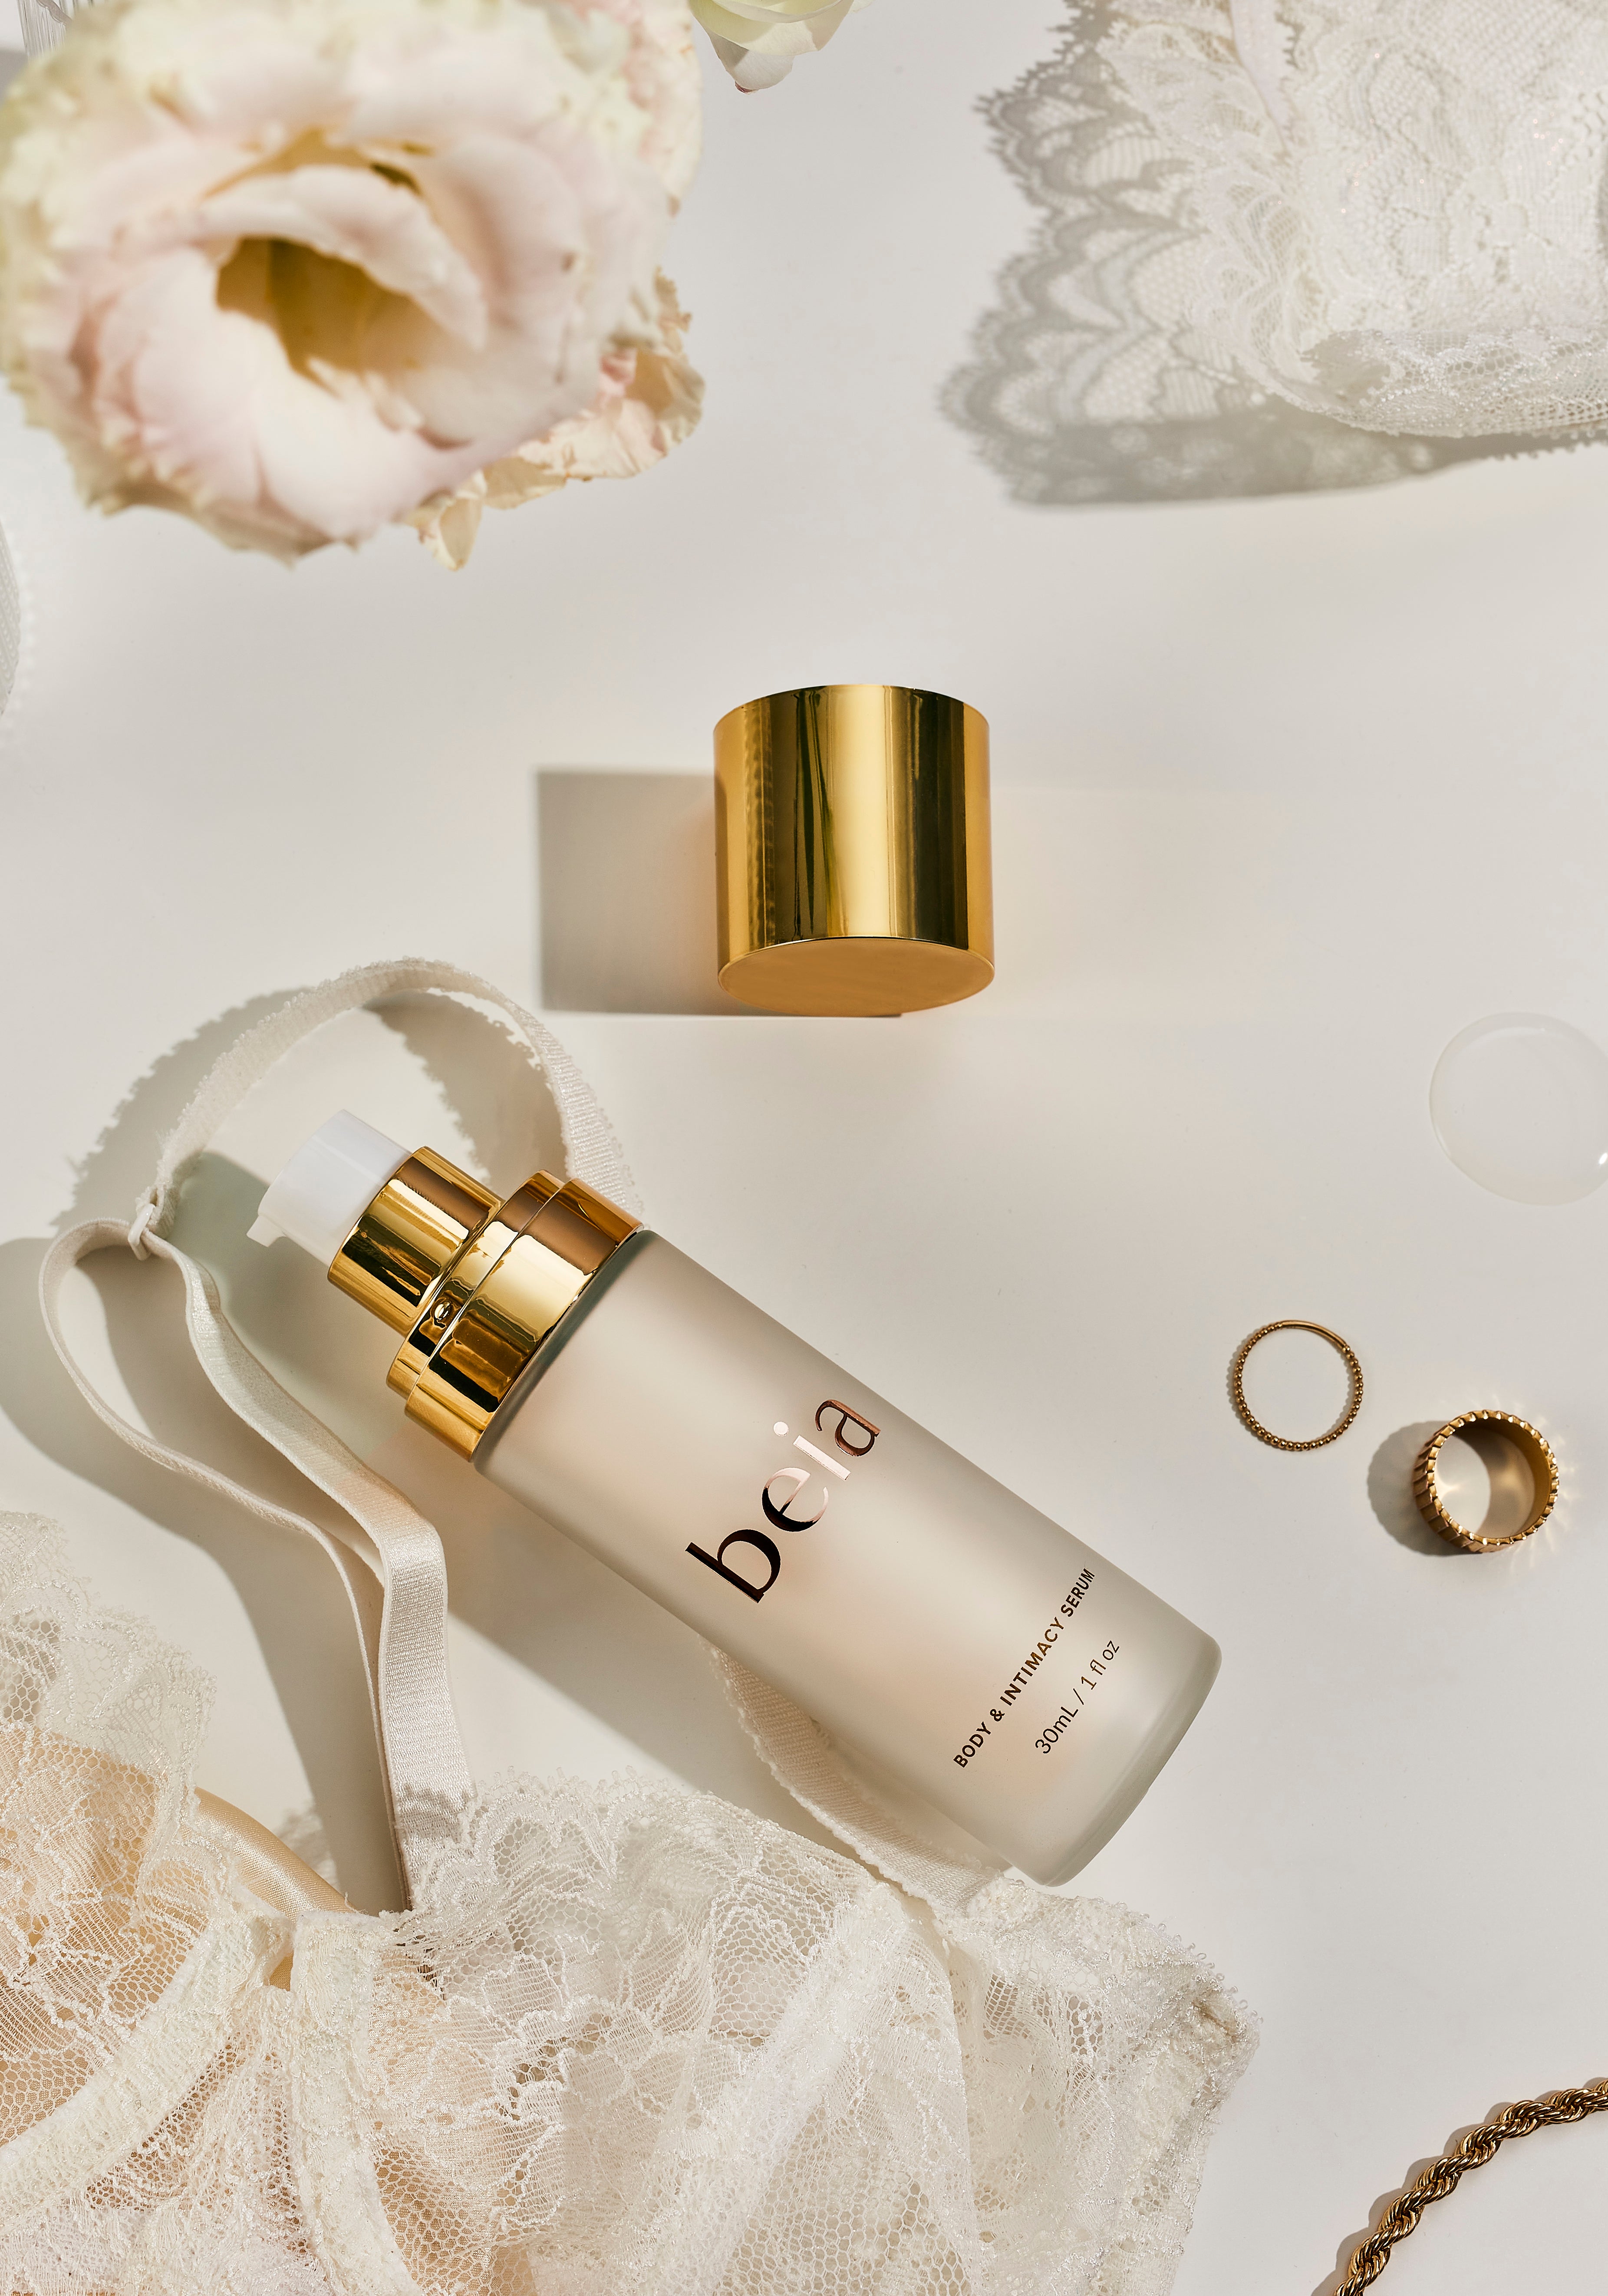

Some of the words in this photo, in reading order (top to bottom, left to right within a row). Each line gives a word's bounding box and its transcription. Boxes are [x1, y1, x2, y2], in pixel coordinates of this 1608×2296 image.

[685, 1399, 881, 1603] beia
[953, 1721, 991, 1768] BODY
[989, 1709, 1005, 1722] &
[1000, 1617, 1064, 1706] INTIMACY
[1061, 1568, 1095, 1617] SERUM
[1035, 1706, 1079, 1754] 30mL
[1073, 1688, 1084, 1705] /
[1081, 1676, 1097, 1690] 1
[1090, 1659, 1107, 1676] fl
[1102, 1640, 1120, 1660] oz
